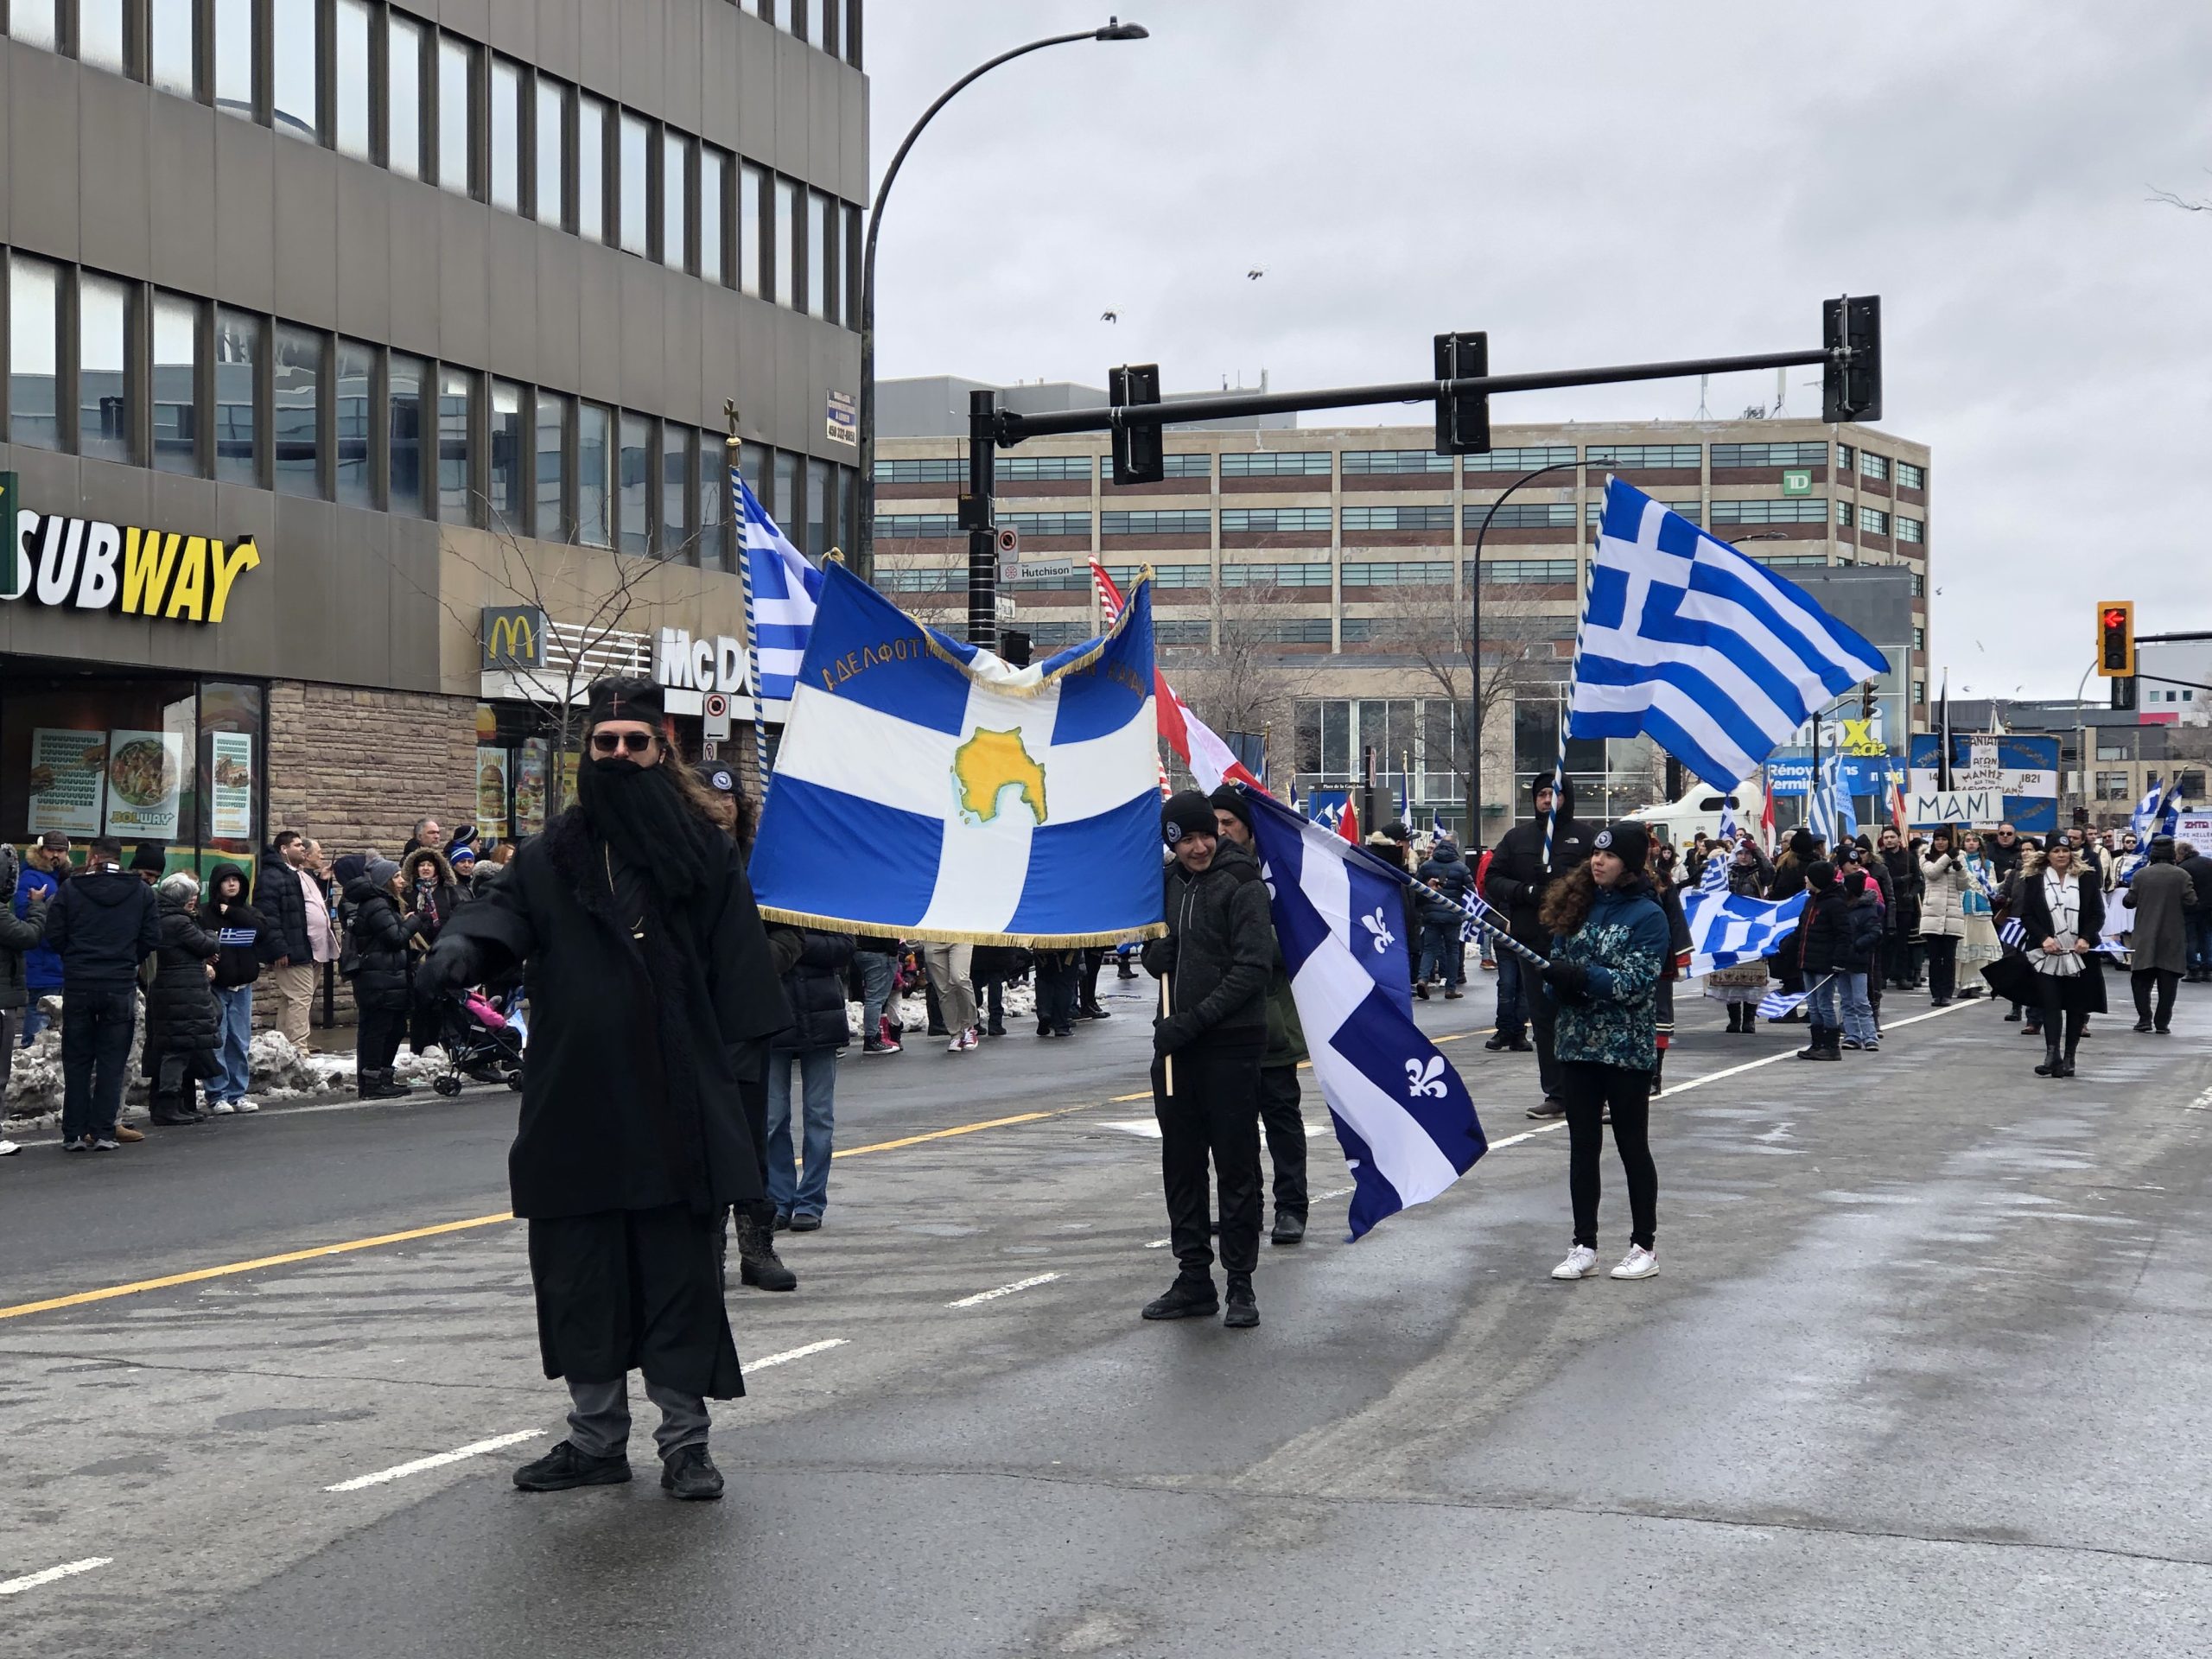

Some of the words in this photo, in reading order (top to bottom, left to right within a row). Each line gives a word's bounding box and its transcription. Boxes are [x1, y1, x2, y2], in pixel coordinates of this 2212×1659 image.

[1785, 474, 1809, 490] TD
[0, 508, 261, 623] SUBWAY
[1021, 566, 1070, 578] Hutchison
[659, 626, 753, 696] McD
[1783, 709, 1883, 748] maxi
[2021, 773, 2041, 784] 1821
[110, 810, 175, 826] BOLWAY
